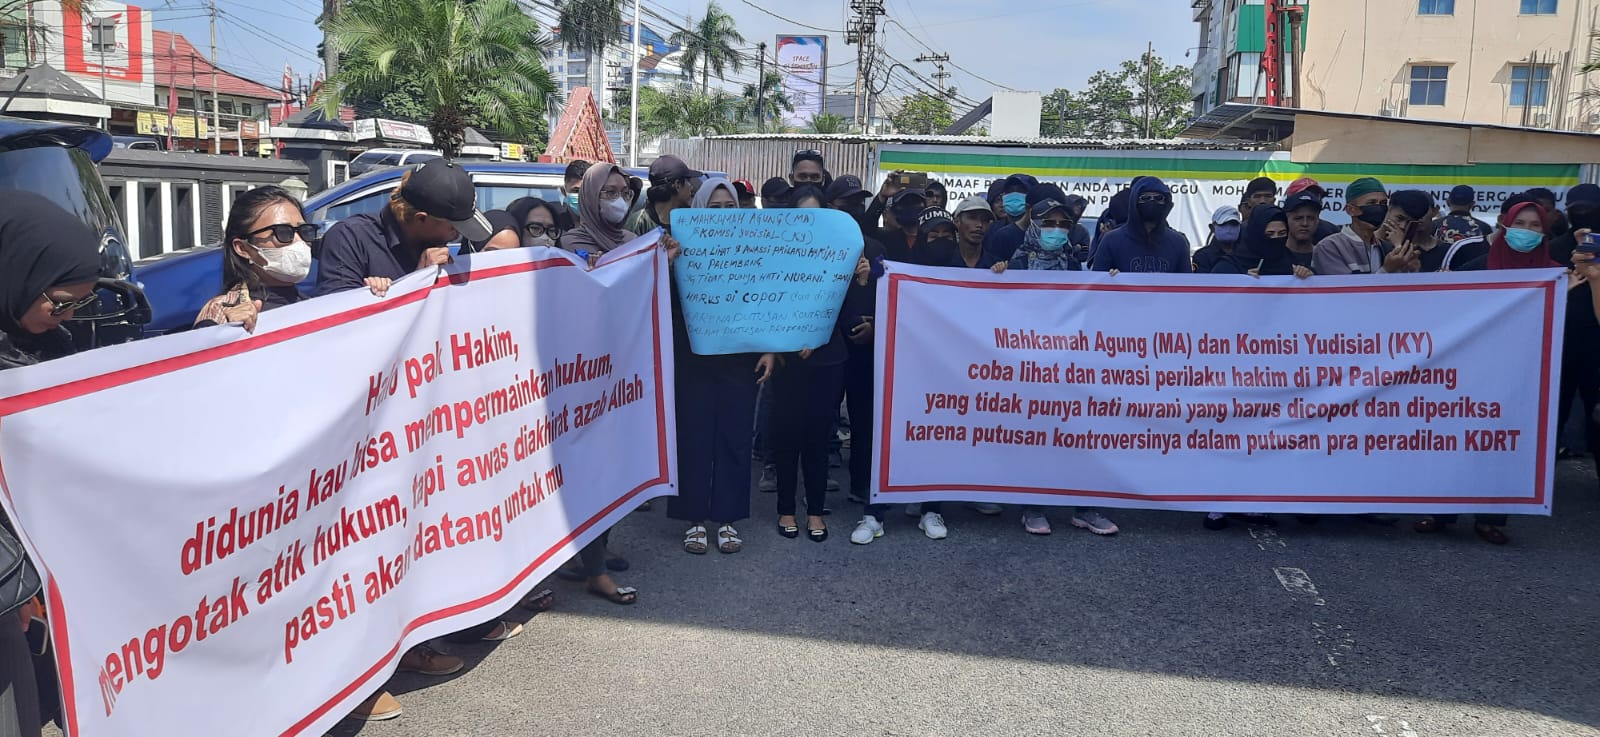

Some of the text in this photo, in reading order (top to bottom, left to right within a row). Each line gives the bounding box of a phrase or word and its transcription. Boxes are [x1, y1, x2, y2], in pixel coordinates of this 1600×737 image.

[944, 178, 980, 189] MAAF
[1073, 182, 1111, 193] ANDA
[742, 291, 785, 306] COPOT
[994, 328, 1433, 359] Mahkamah Agung (MA) dan Komisi Yudisial (KY)
[404, 340, 443, 398] pak
[450, 325, 518, 370] Hakim,
[968, 360, 1457, 391] coba lihat dan awasi perilaku hakim di PN Palembang
[925, 392, 1501, 423] yang tidak punya hati nurani yang harus dicopot dan diperiksa
[905, 420, 1521, 456] karena putusan kontroversinya dalam putusan pra peradilan KDRT
[181, 353, 612, 575] didunia kau bisa mempermainkan hukum,
[98, 373, 643, 717] mengotak atik hukum, tapi awas diakhirat azab Allah
[285, 463, 564, 664] pasti akan datang untuk mu
